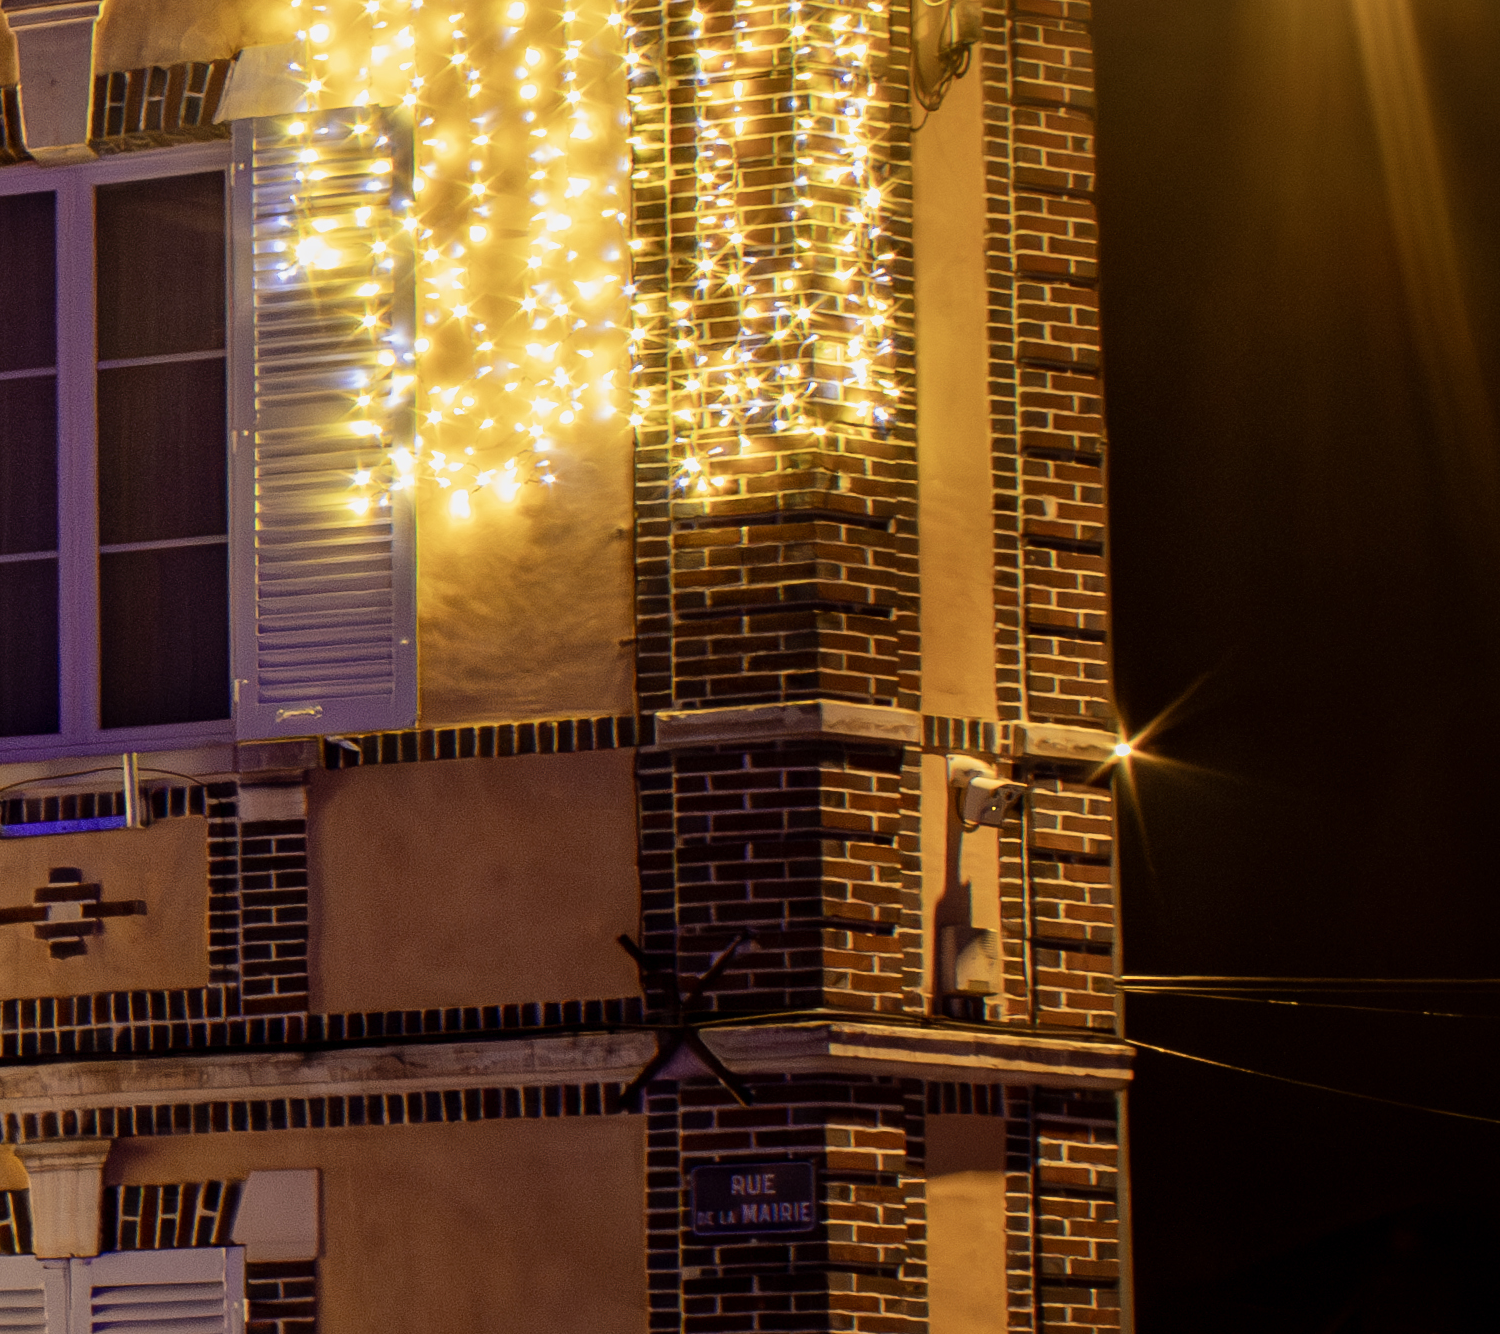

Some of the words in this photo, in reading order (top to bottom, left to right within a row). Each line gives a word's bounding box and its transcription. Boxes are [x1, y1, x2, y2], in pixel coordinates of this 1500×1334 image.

[730, 1173, 776, 1196] RUE
[697, 1211, 715, 1226] DE
[719, 1211, 736, 1225] LA
[742, 1202, 812, 1225] MAIRIE
